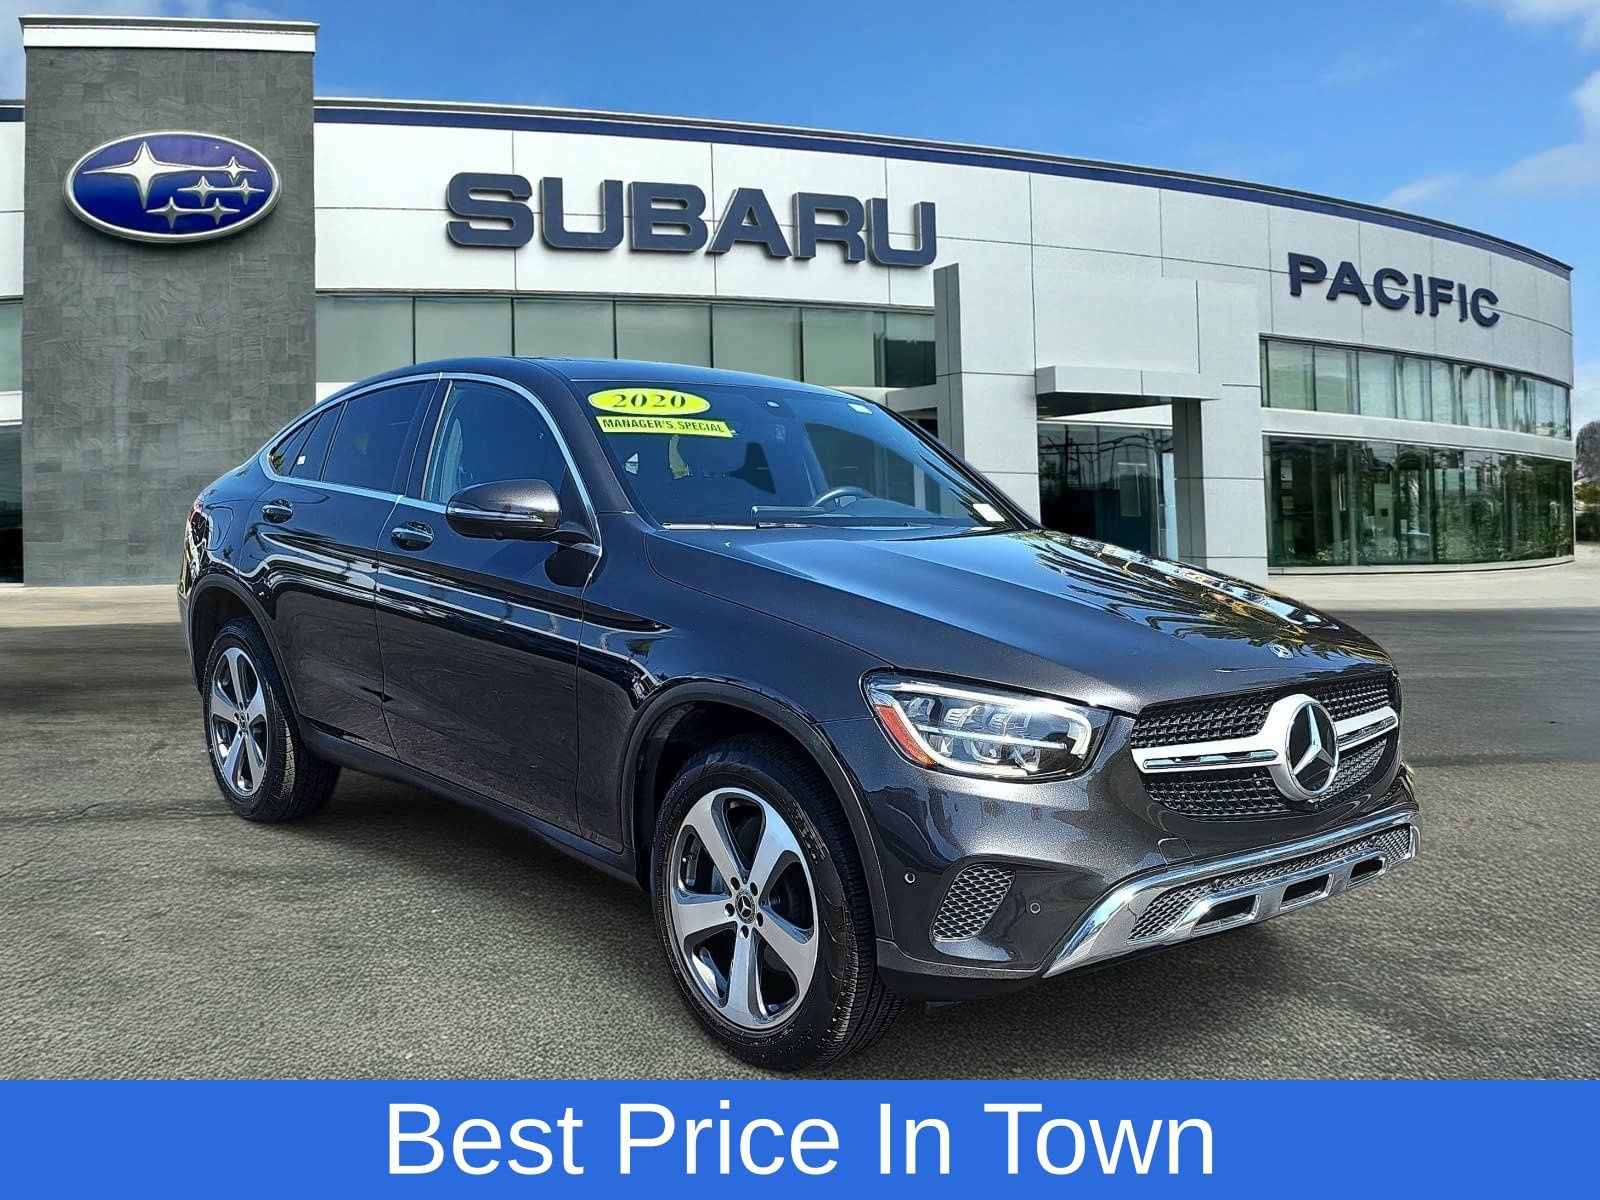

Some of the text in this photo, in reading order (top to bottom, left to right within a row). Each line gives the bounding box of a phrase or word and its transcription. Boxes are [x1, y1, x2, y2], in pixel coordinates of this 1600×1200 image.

[446, 171, 938, 268] SUBARU
[1287, 252, 1500, 327] PACIFIC
[612, 393, 687, 408] 2020
[602, 418, 725, 433] MANAGER'S SPECIAL
